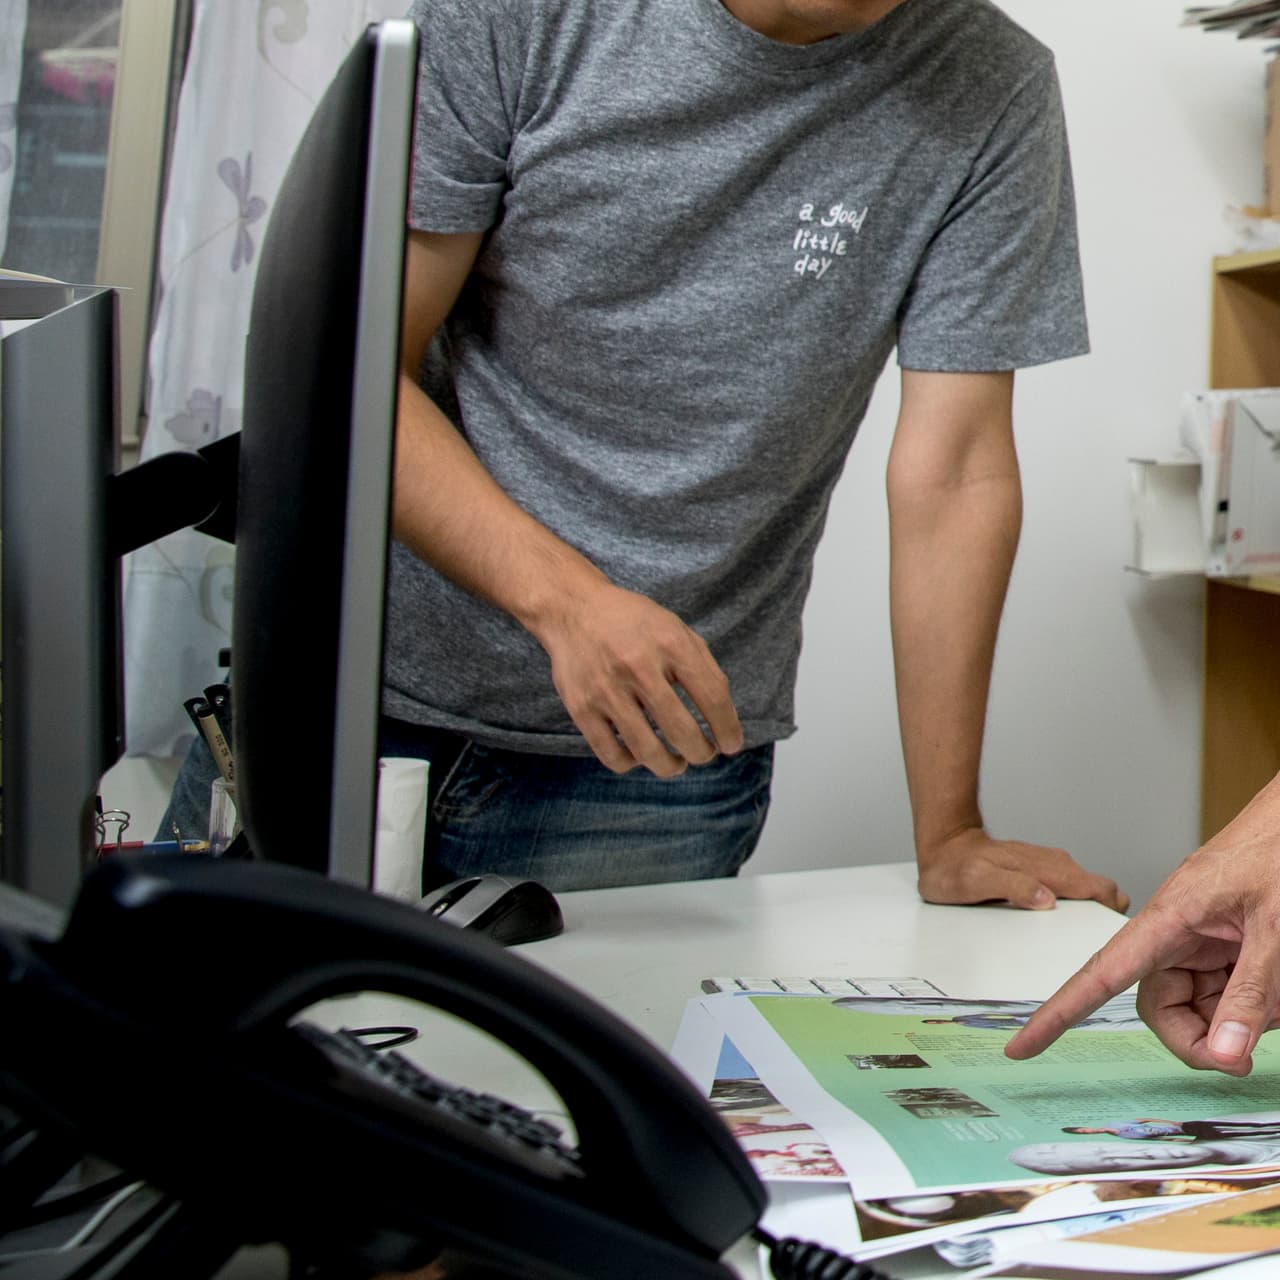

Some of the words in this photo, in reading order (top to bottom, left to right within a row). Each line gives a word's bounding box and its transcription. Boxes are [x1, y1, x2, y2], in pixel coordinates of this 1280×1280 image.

[799, 203, 814, 221] a
[820, 202, 869, 234] good
[793, 229, 848, 256] little
[794, 254, 833, 280] day
